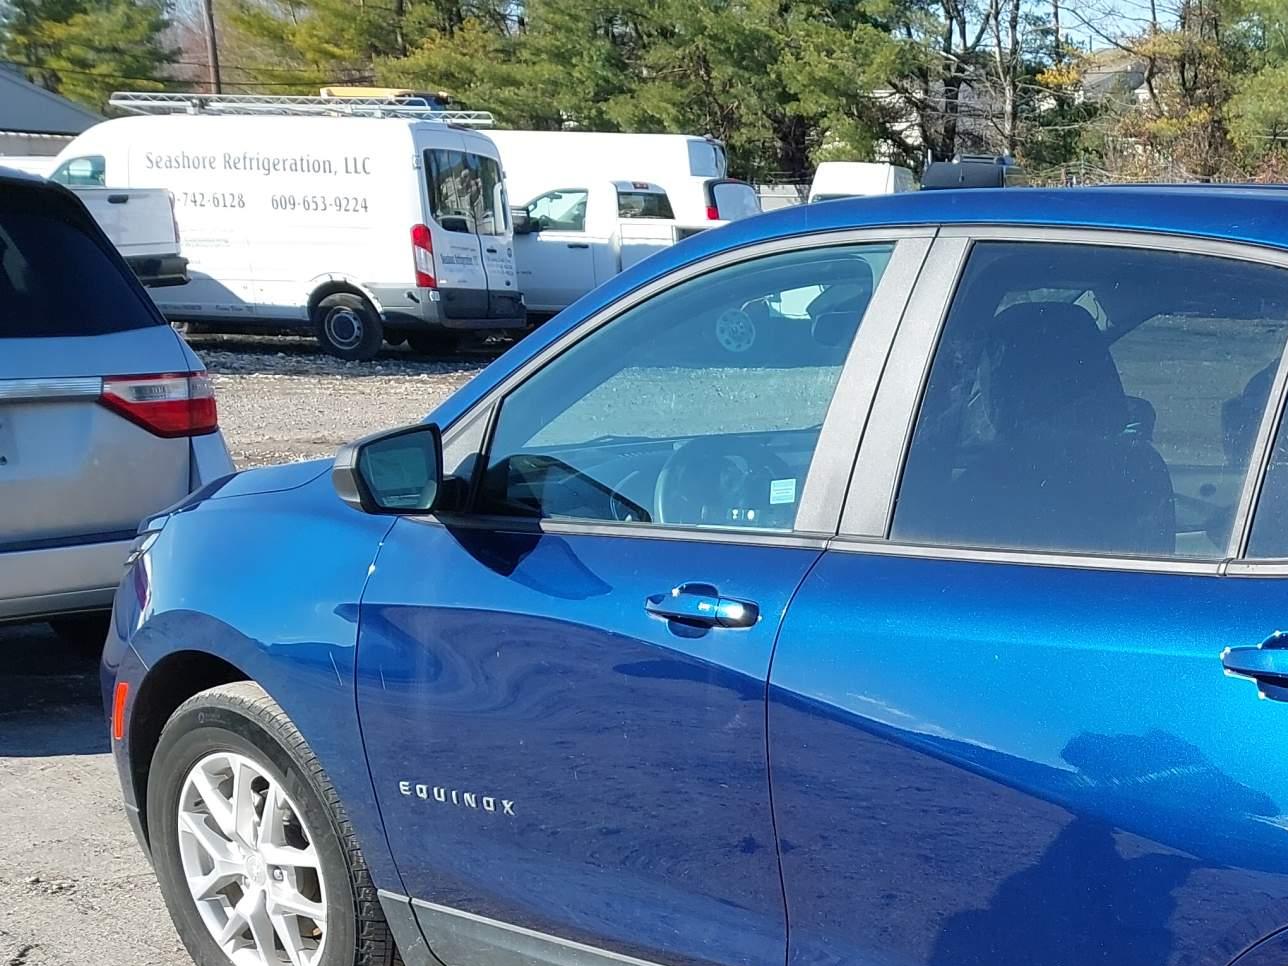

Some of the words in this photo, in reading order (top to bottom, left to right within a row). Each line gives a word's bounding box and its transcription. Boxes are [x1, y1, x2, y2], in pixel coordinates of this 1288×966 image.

[145, 151, 217, 171] Seashore
[223, 153, 338, 176] Refrigeration,
[344, 156, 371, 175] LLC
[271, 194, 369, 213] 609-653-9224
[398, 780, 516, 816] EQUINOX
